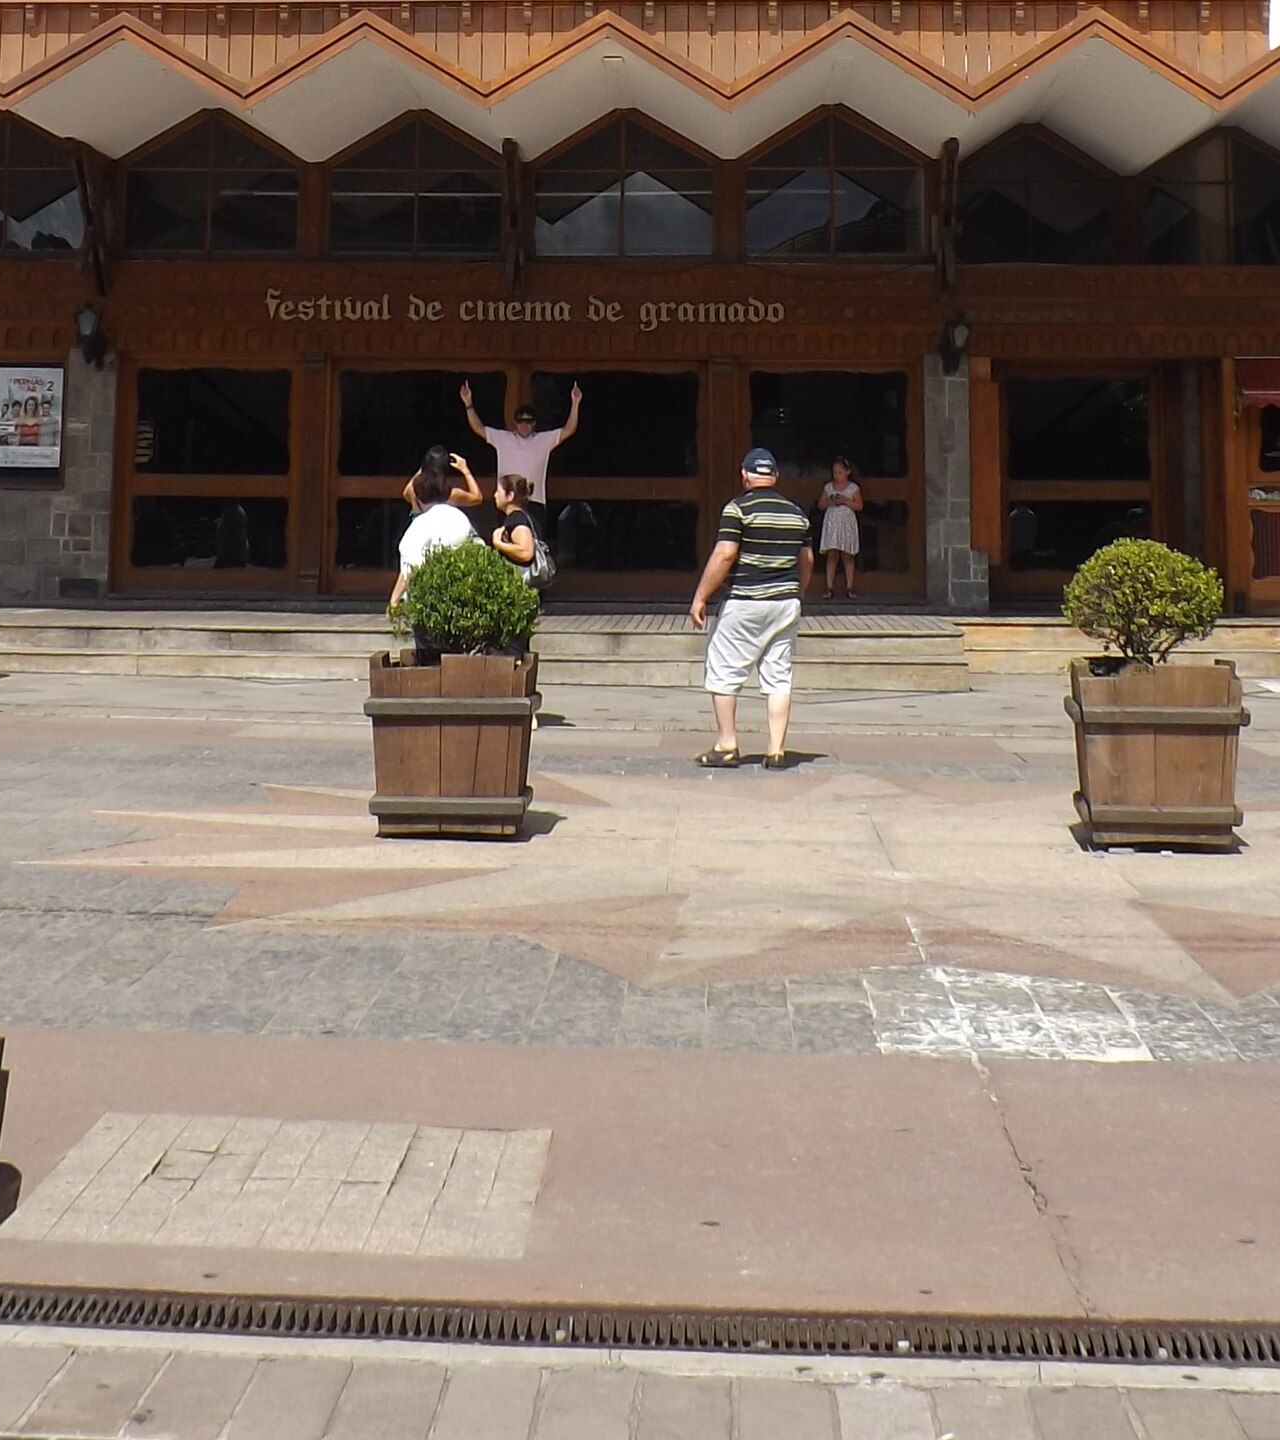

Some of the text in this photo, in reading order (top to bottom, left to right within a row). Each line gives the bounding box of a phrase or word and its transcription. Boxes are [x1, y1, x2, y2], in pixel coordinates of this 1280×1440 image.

[406, 295, 445, 322] de
[459, 300, 571, 323] cinema
[586, 297, 625, 322] de
[639, 297, 786, 330] gramado
[46, 380, 55, 392] 2
